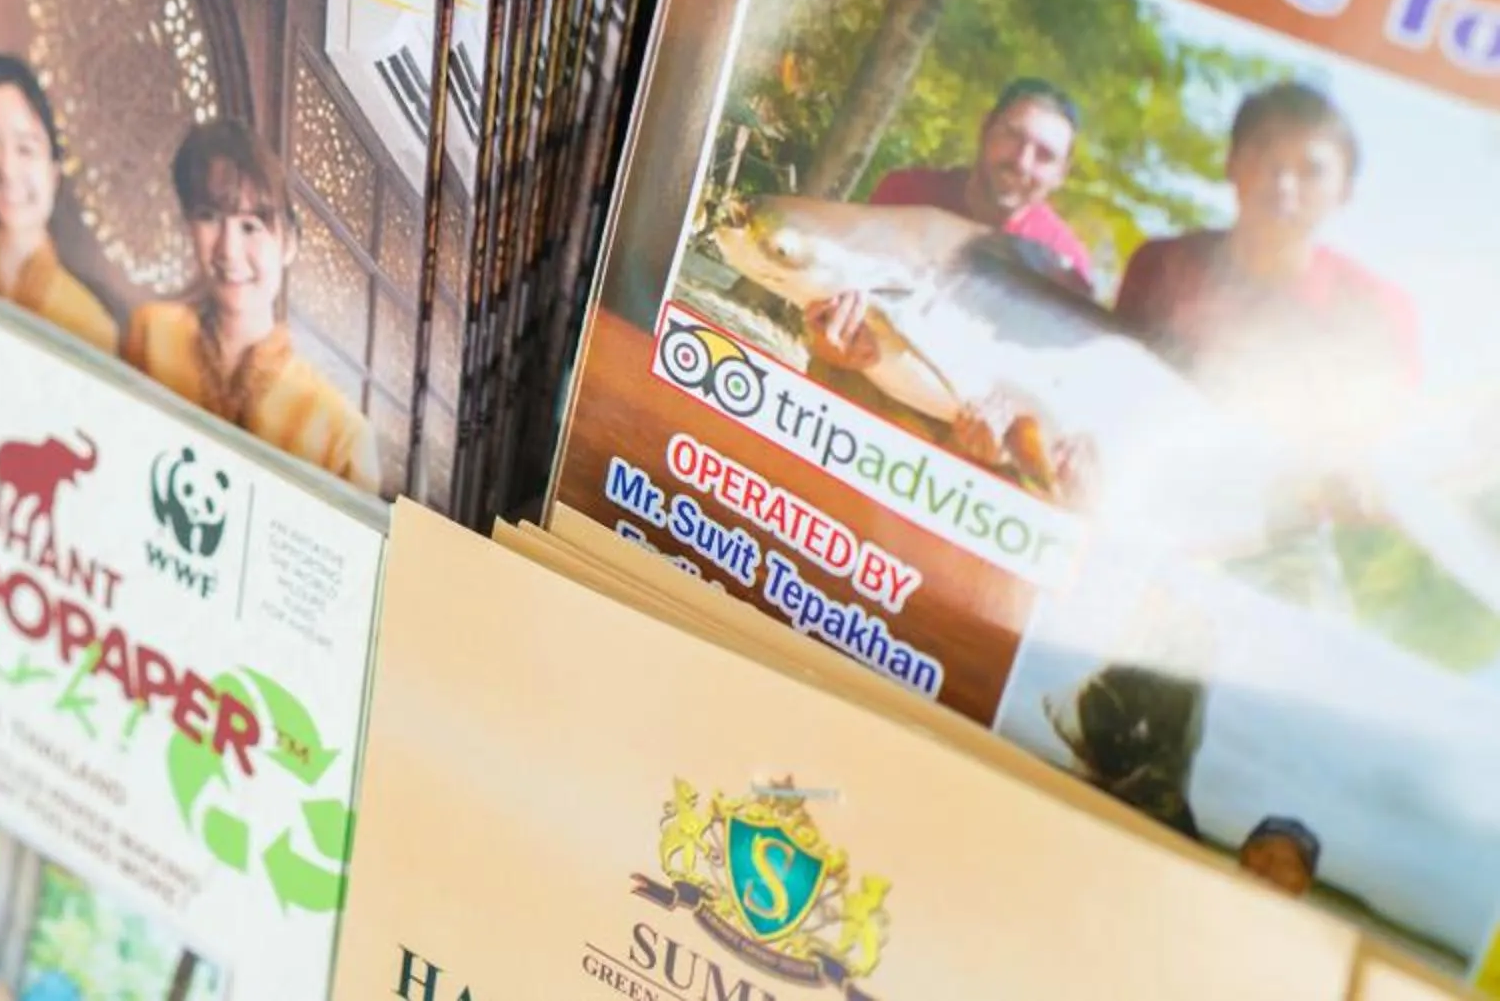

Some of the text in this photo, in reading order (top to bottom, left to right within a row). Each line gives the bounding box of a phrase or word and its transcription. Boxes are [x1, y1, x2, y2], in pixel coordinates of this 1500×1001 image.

[143, 539, 218, 600] WWF
[666, 432, 857, 574] OPERATED
[855, 550, 922, 613] BY
[775, 388, 1061, 574] tripadvisor
[605, 456, 666, 525] Mr.
[670, 499, 758, 581] Suvit
[763, 554, 942, 696] Tepakhan
[629, 921, 777, 1001] SUM
